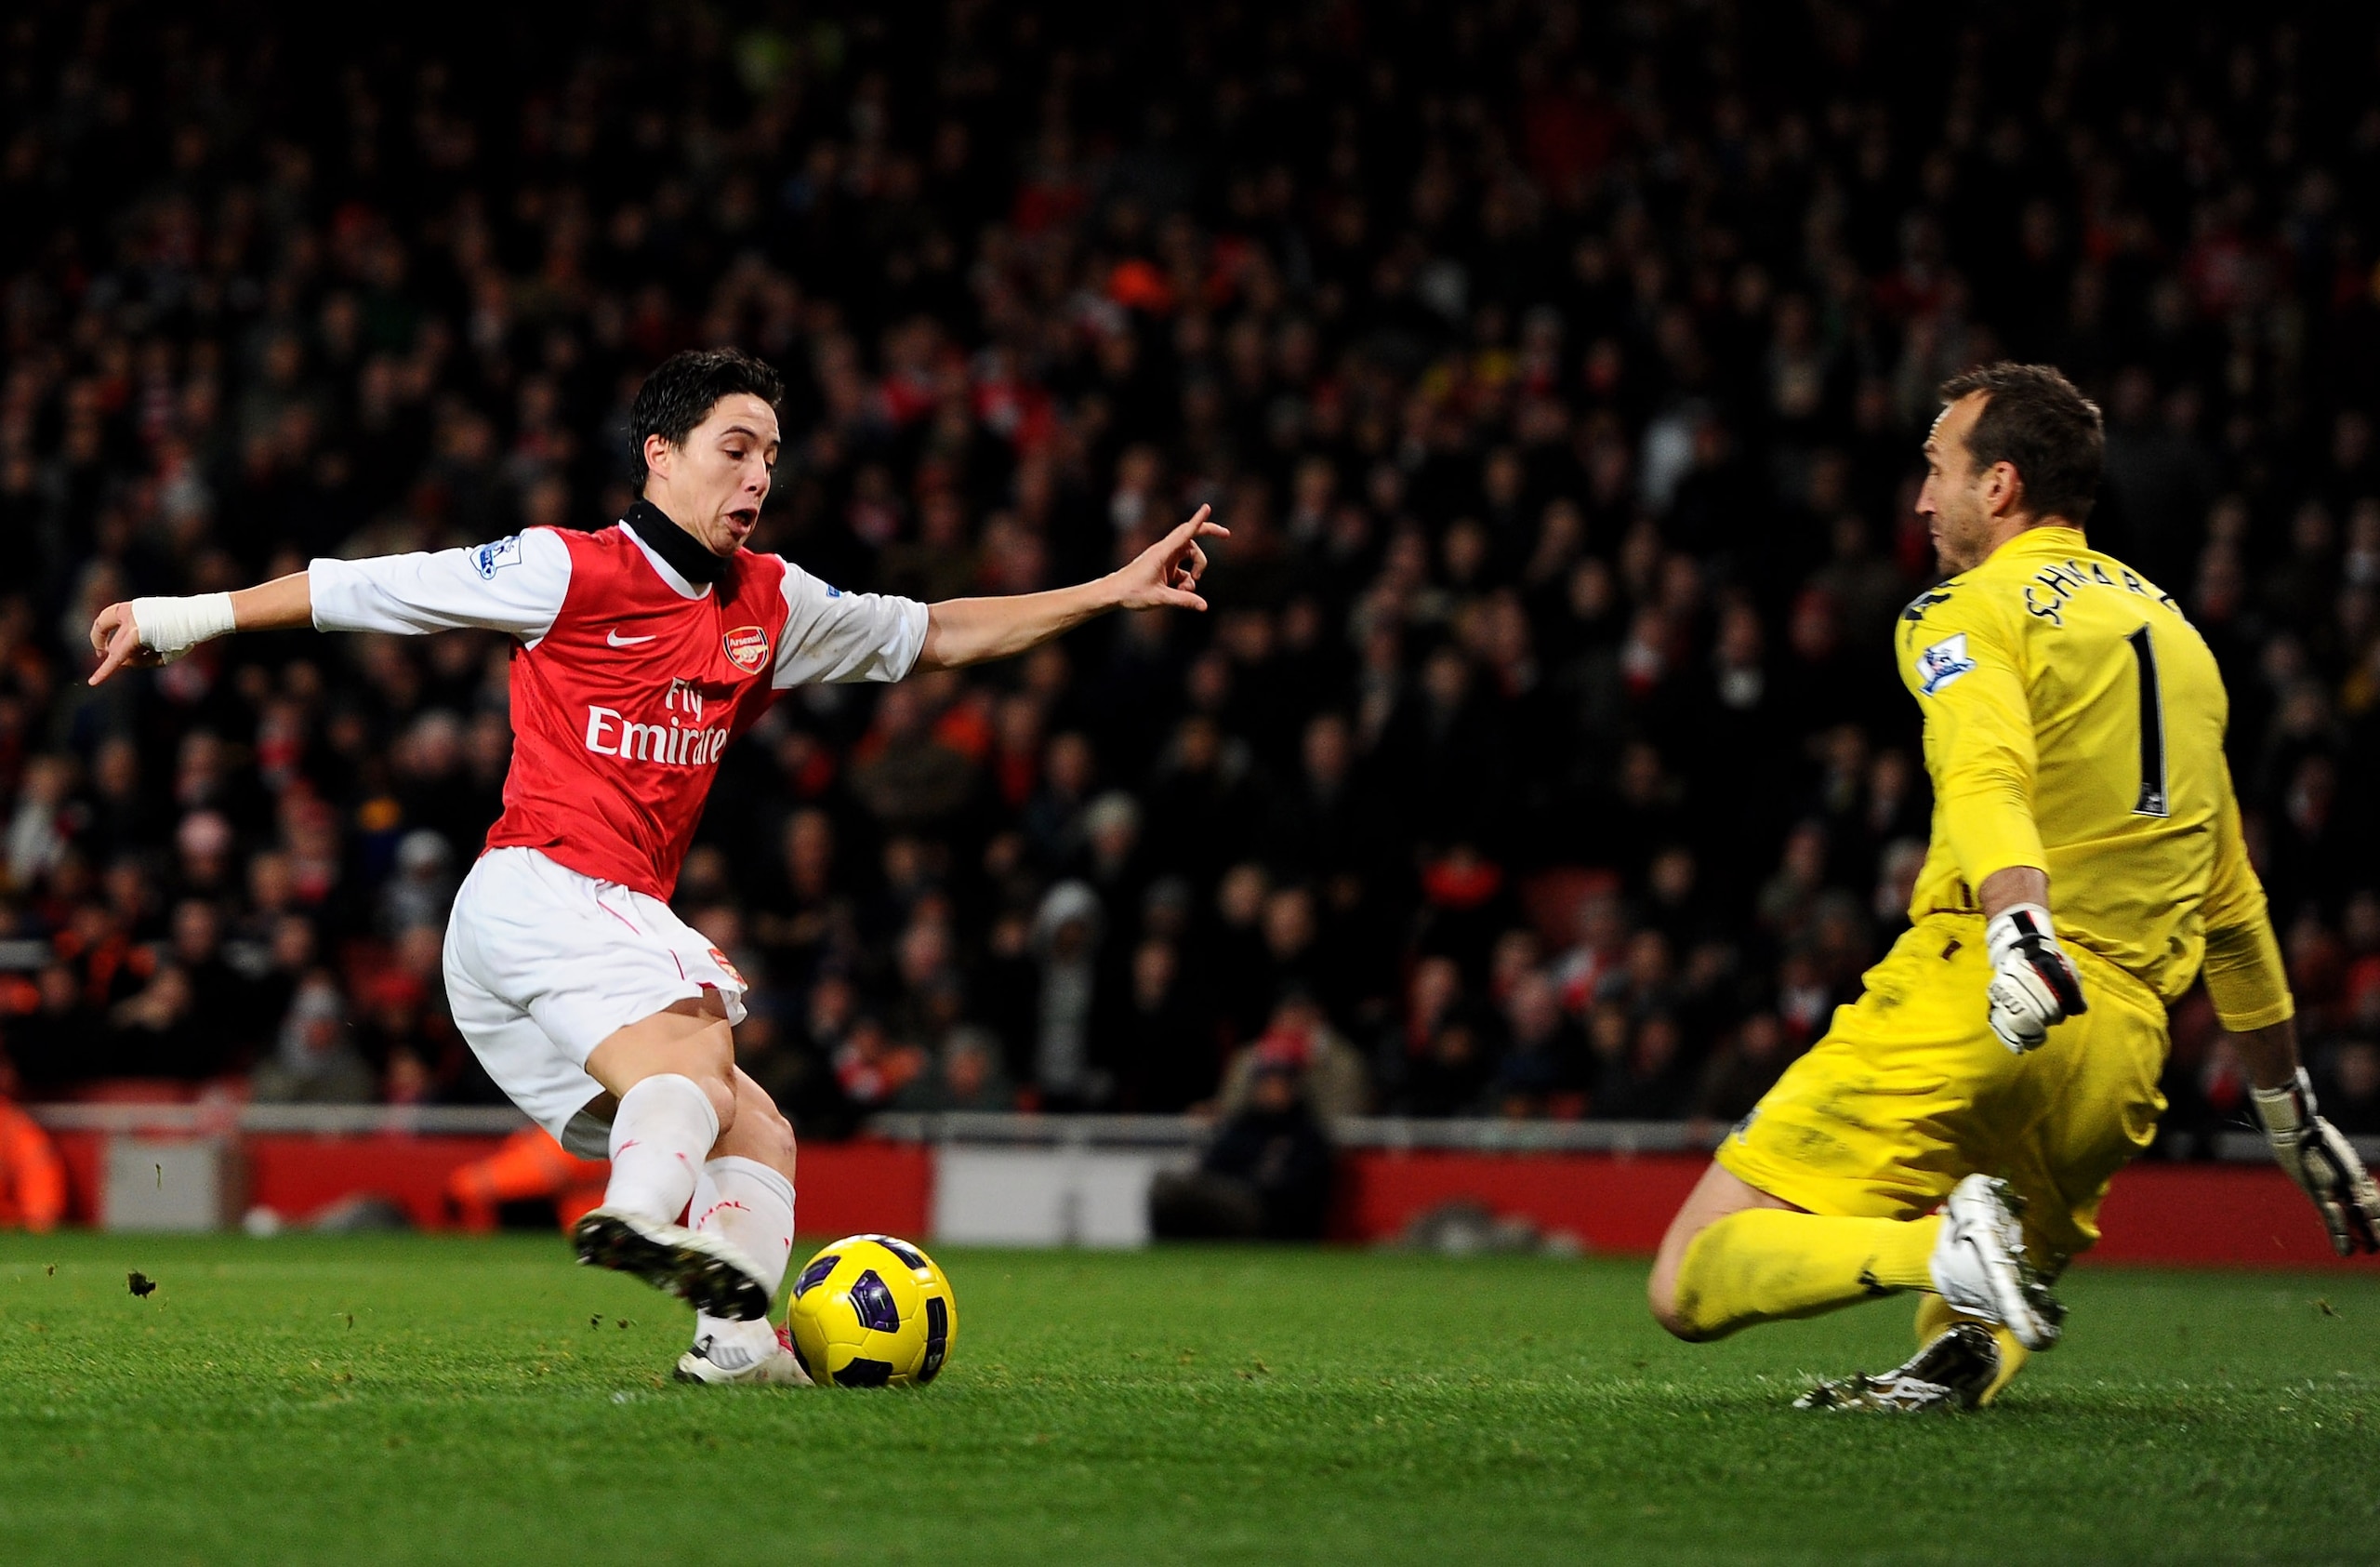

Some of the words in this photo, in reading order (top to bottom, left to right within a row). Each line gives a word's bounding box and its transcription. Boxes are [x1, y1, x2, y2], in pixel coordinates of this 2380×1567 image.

[729, 633, 761, 647] Arsenal
[665, 677, 703, 722] Fly
[2123, 622, 2170, 818] 1
[585, 704, 731, 765] Emirate
